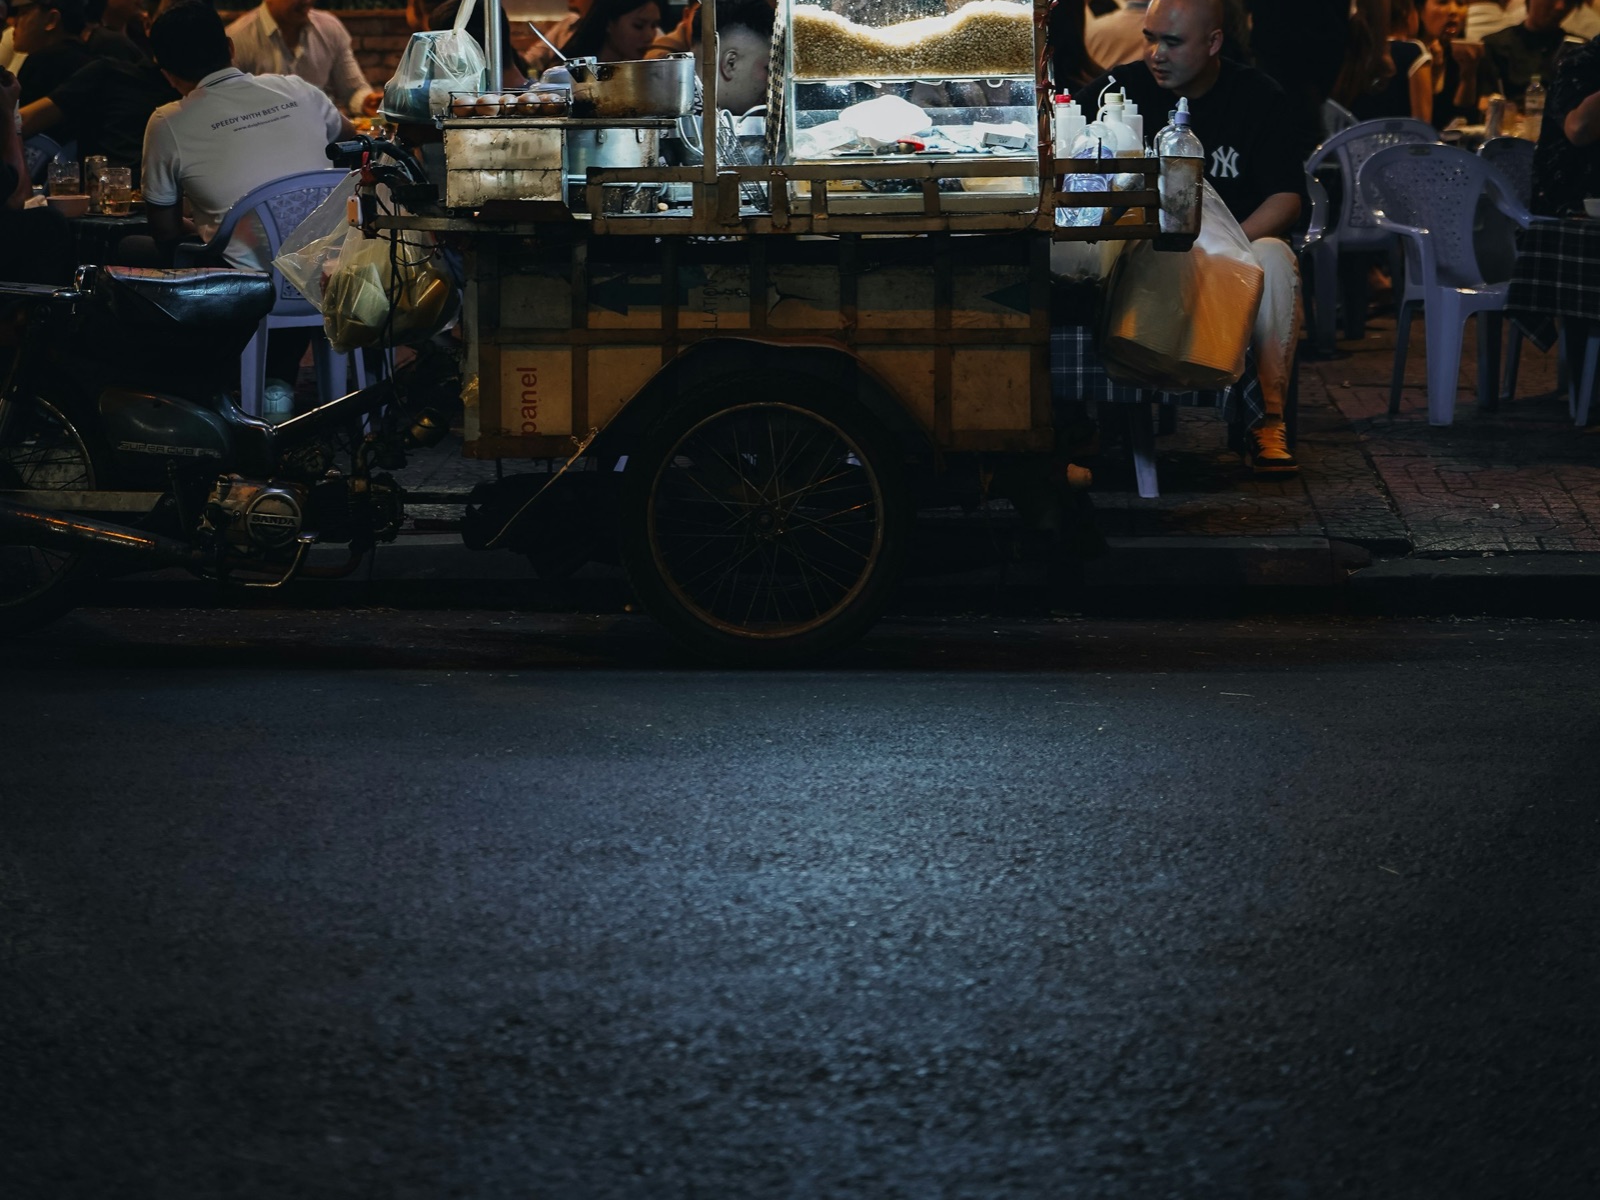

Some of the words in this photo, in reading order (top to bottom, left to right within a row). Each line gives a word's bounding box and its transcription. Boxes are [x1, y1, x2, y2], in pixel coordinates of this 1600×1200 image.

[211, 117, 239, 131] SPEEDY
[240, 111, 262, 122] WITH
[262, 106, 280, 117] BEST
[280, 101, 299, 111] CARE
[1210, 146, 1240, 178] NY
[516, 367, 542, 435] panel
[119, 441, 165, 453] SUPER
[166, 446, 194, 456] CUB
